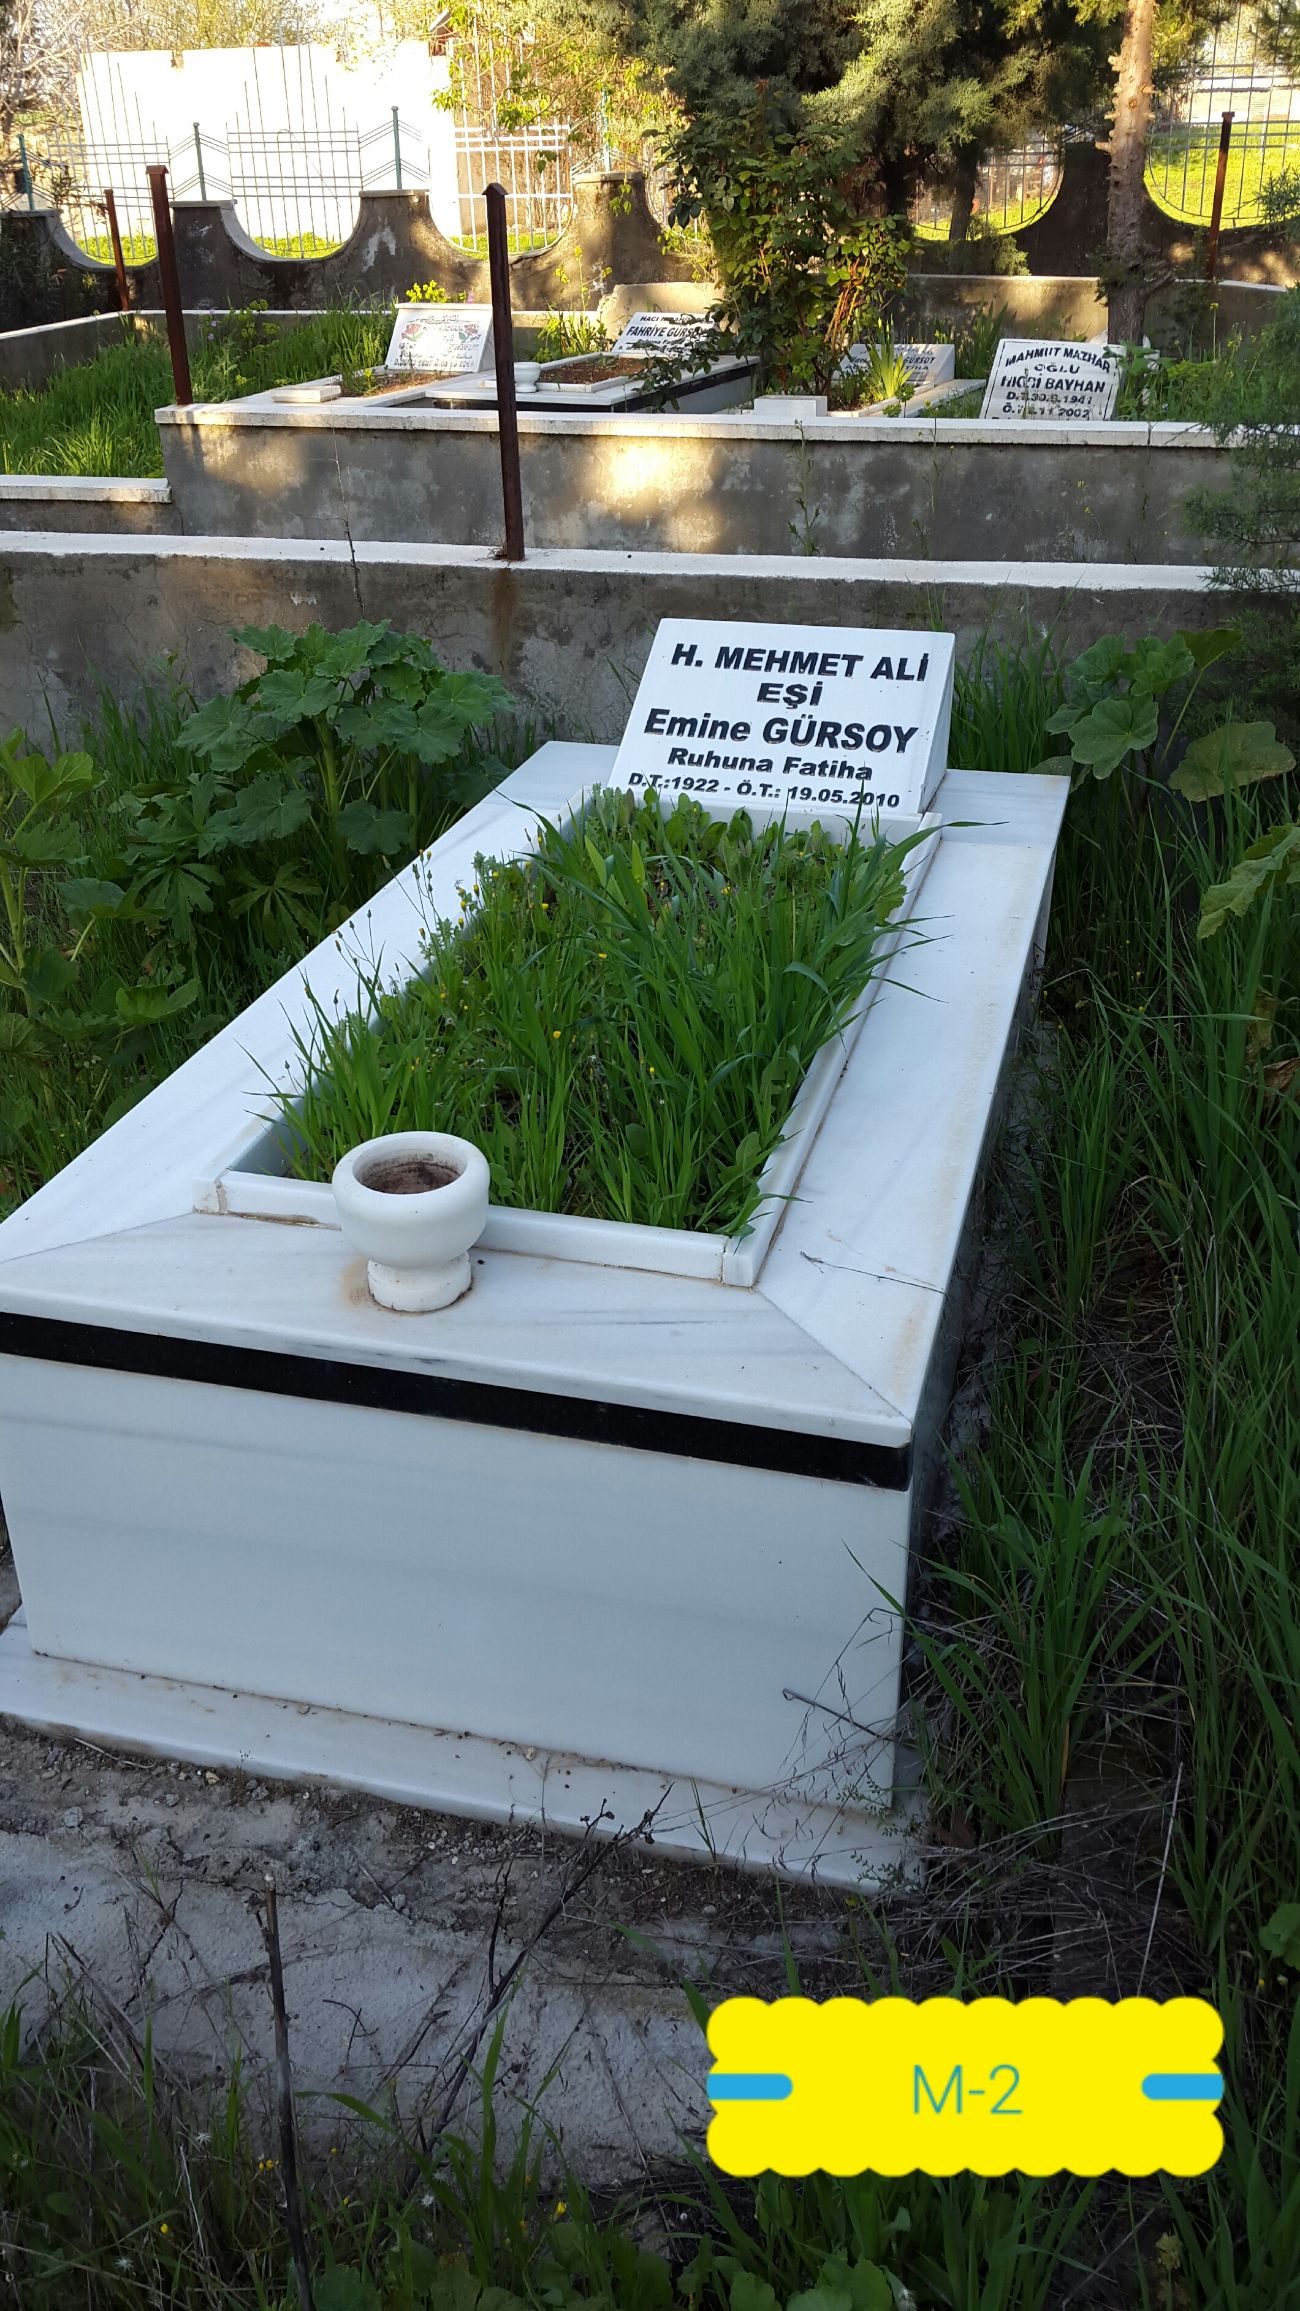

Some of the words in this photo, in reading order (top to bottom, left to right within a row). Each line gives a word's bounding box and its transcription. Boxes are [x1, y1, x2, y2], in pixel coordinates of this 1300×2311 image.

[626, 325, 667, 337] FAHRİYE
[1005, 347, 1062, 367] MAHMUT
[1063, 347, 1111, 374] MAZHAR
[1034, 362, 1081, 373] OĞLU
[1045, 377, 1106, 393] BAYHAN
[671, 643, 703, 667] H.
[715, 646, 864, 678] MEHMET
[870, 653, 929, 682] ALİ
[757, 681, 823, 709] EŞİ
[644, 708, 751, 742] Emine
[762, 714, 918, 754] GÜRSOY
[668, 748, 773, 774] Ruhuna
[782, 756, 873, 781] Fatiha
[788, 786, 900, 808] 19.05.2010
